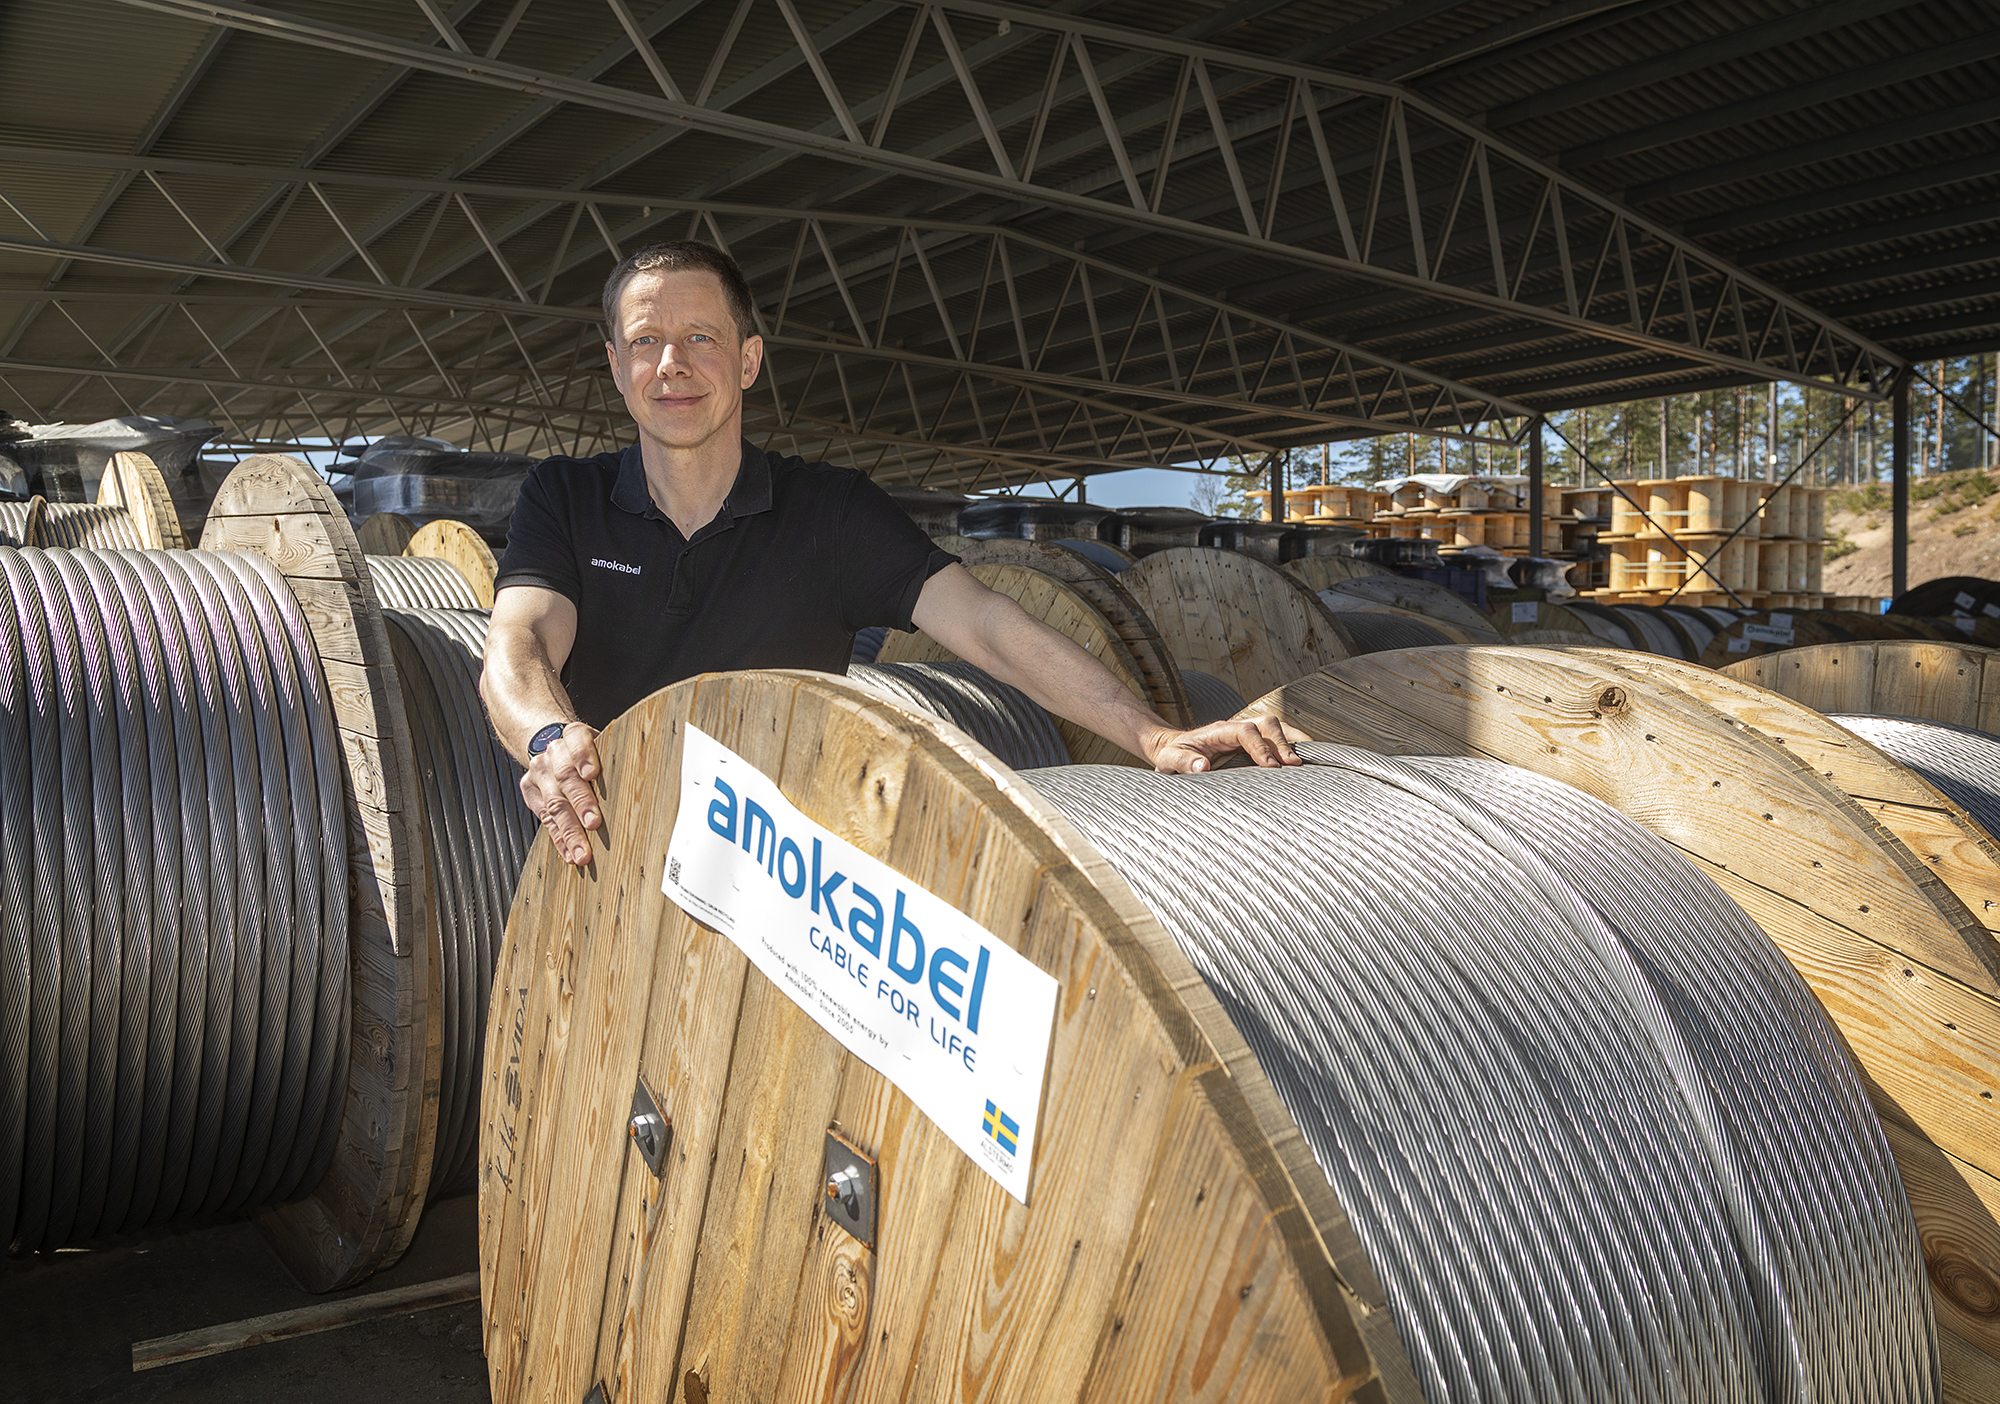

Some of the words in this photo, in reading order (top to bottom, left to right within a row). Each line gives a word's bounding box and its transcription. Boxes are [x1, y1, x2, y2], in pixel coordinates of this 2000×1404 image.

[591, 558, 642, 575] amokabel
[707, 776, 990, 1035] amokabel
[510, 988, 528, 1064] VIDA
[761, 936, 785, 964] Produced
[787, 962, 799, 976] with
[801, 970, 818, 991] 100%
[819, 989, 851, 1019] renewable
[853, 1018, 877, 1041] energy
[879, 1033, 889, 1049] by
[785, 971, 814, 1000] Amokabel
[819, 999, 835, 1018] Since
[837, 1014, 854, 1034] 2005
[810, 926, 869, 988] CABLE
[877, 979, 920, 1028] FOR
[930, 1017, 976, 1073] LIFE
